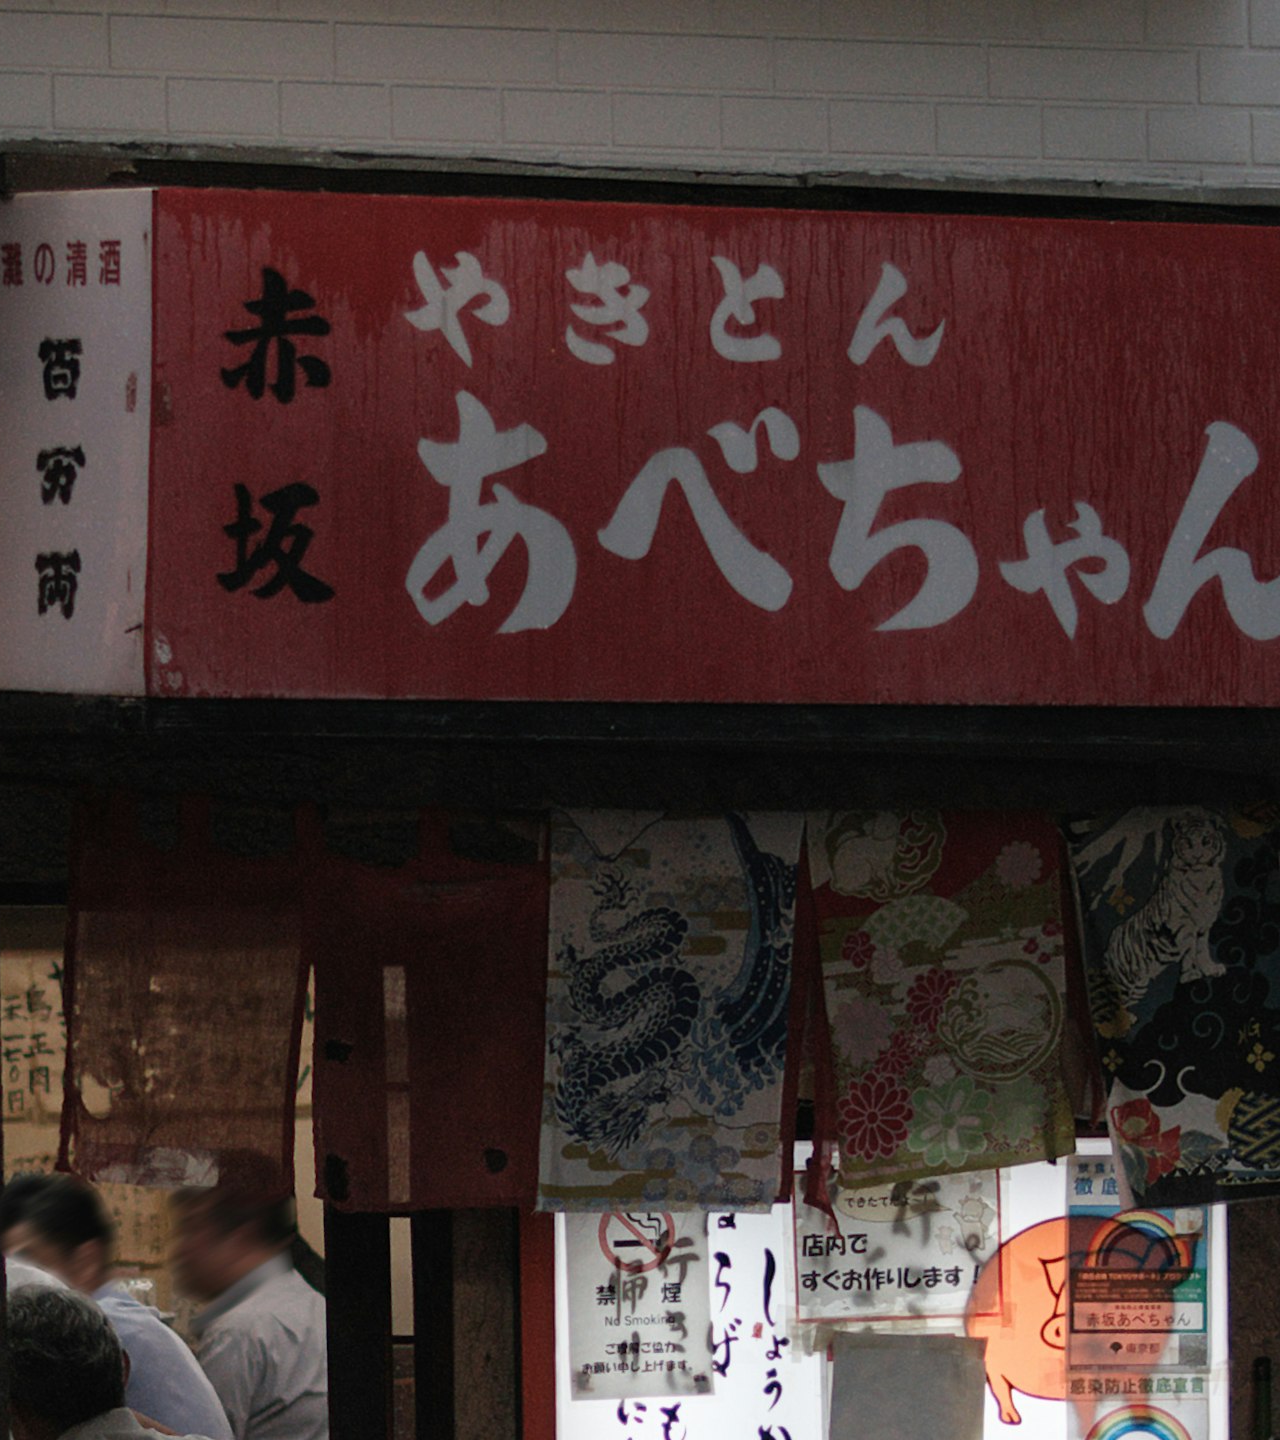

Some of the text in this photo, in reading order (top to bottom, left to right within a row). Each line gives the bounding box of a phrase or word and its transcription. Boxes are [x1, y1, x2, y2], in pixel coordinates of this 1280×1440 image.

[405, 250, 945, 367] やきとん
[217, 267, 336, 602] 赤坂
[802, 1233, 868, 1257] 店内で
[595, 1282, 682, 1306] 禁煙
[605, 1314, 677, 1328] No Smoking
[1087, 1312, 1191, 1327] 赤坂あべちゃん
